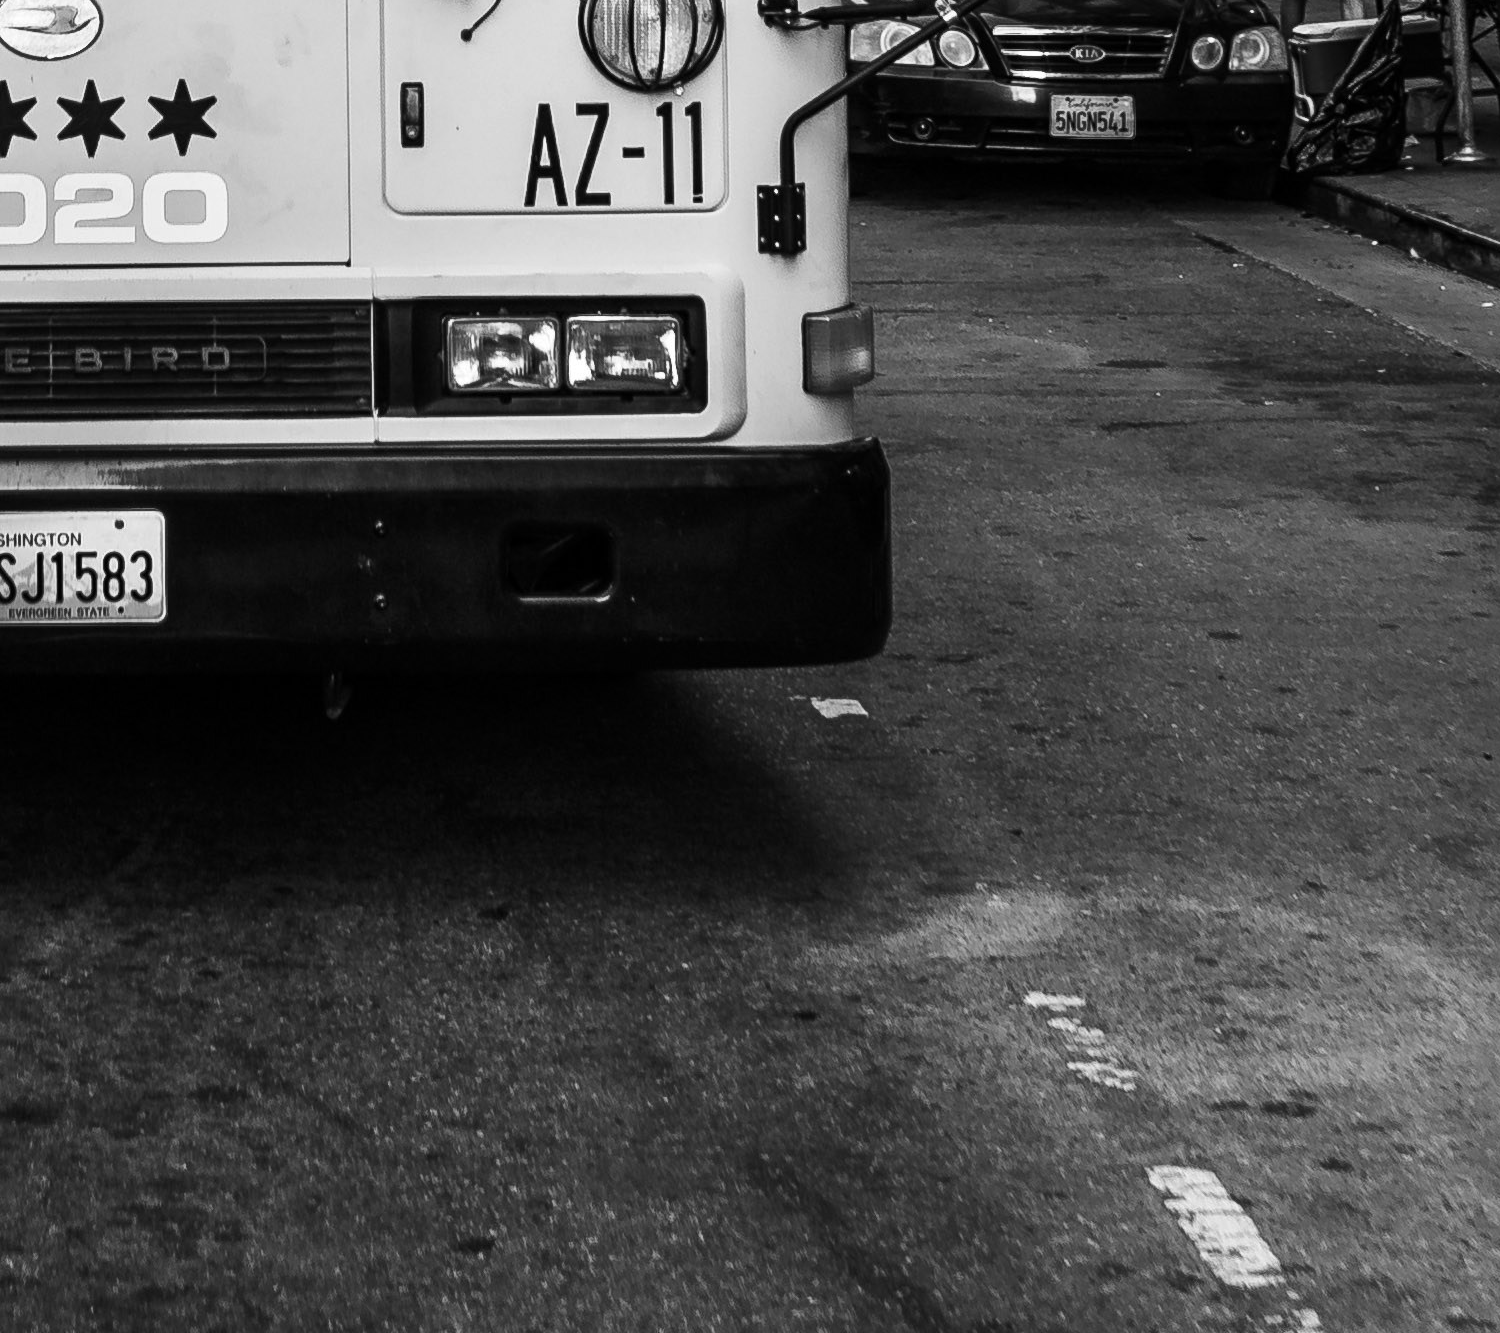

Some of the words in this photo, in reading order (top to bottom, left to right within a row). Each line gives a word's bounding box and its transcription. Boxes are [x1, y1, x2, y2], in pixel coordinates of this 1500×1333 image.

[1055, 110, 1129, 135] 5NGN541
[523, 100, 704, 208] AZ-11
[75, 346, 231, 373] BIRD
[8, 607, 73, 620] EVERGREEN
[76, 606, 111, 619] STATE
